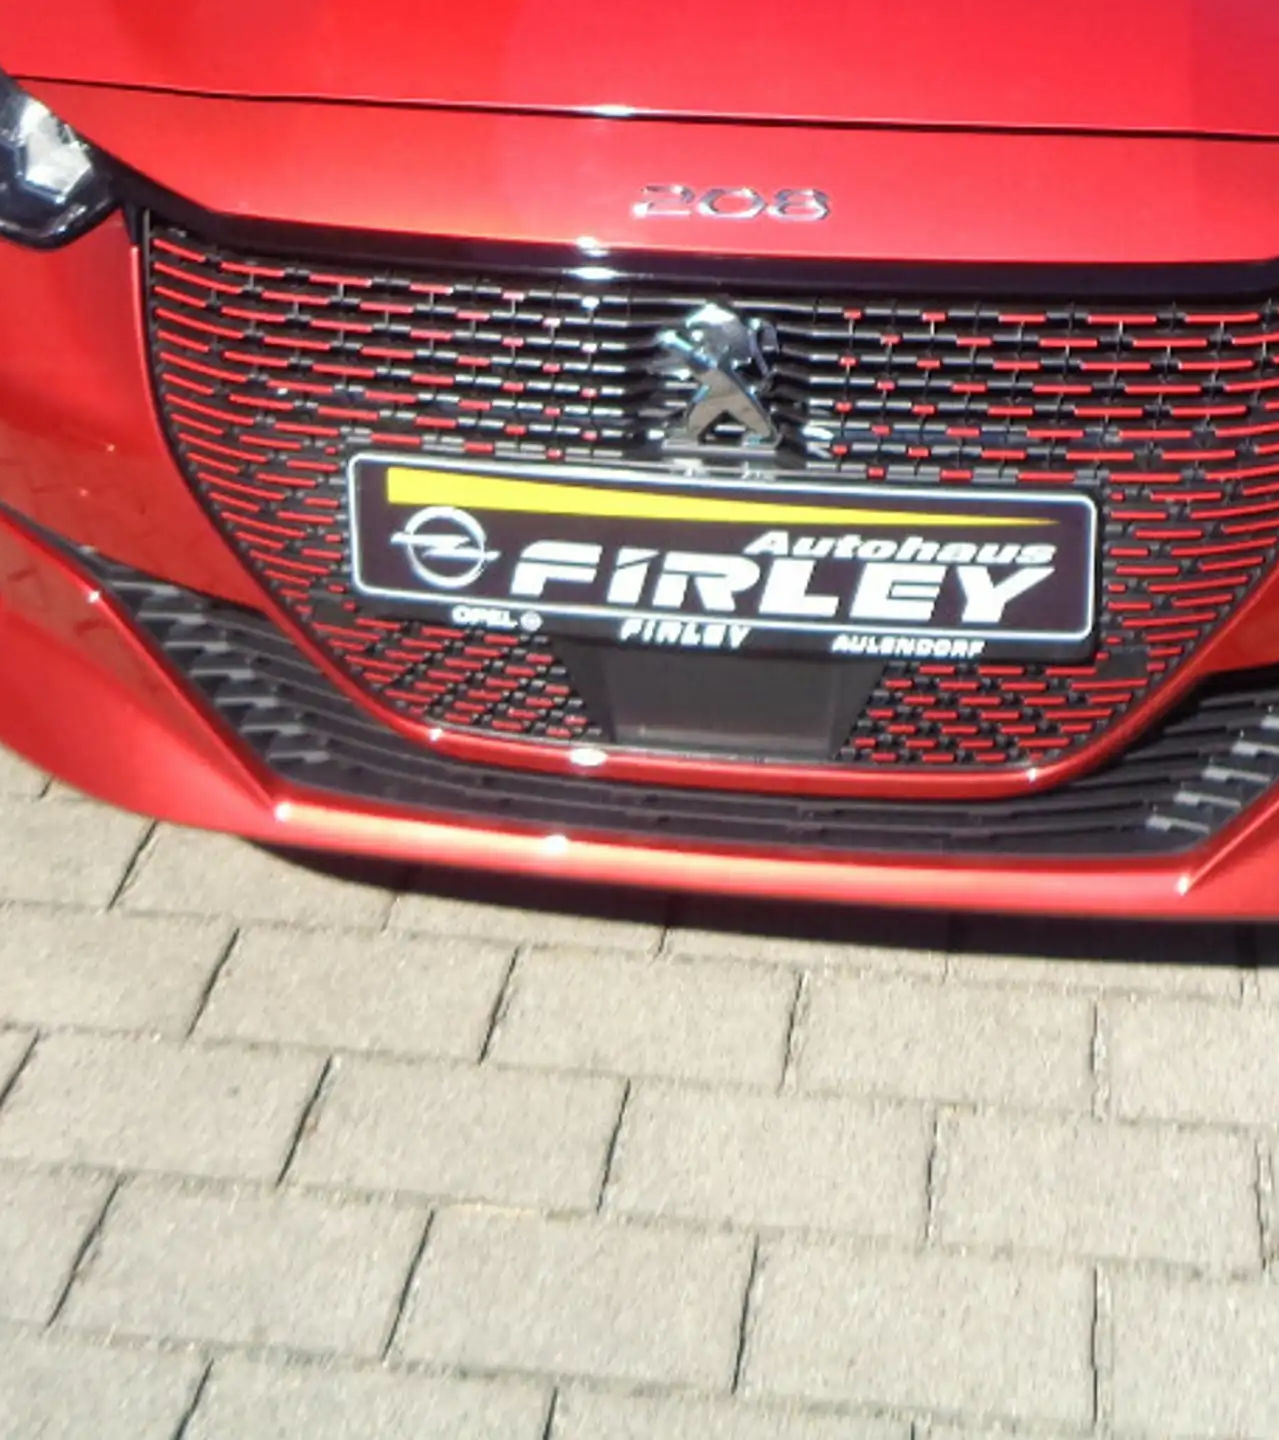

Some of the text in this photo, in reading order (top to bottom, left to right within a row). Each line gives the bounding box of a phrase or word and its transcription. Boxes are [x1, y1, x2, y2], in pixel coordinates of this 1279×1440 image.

[632, 185, 831, 220] 208
[743, 530, 1058, 565] Autohaus
[508, 539, 1056, 624] FIRLEY
[451, 604, 985, 658] OPEL FIRLEY AULENDORF
